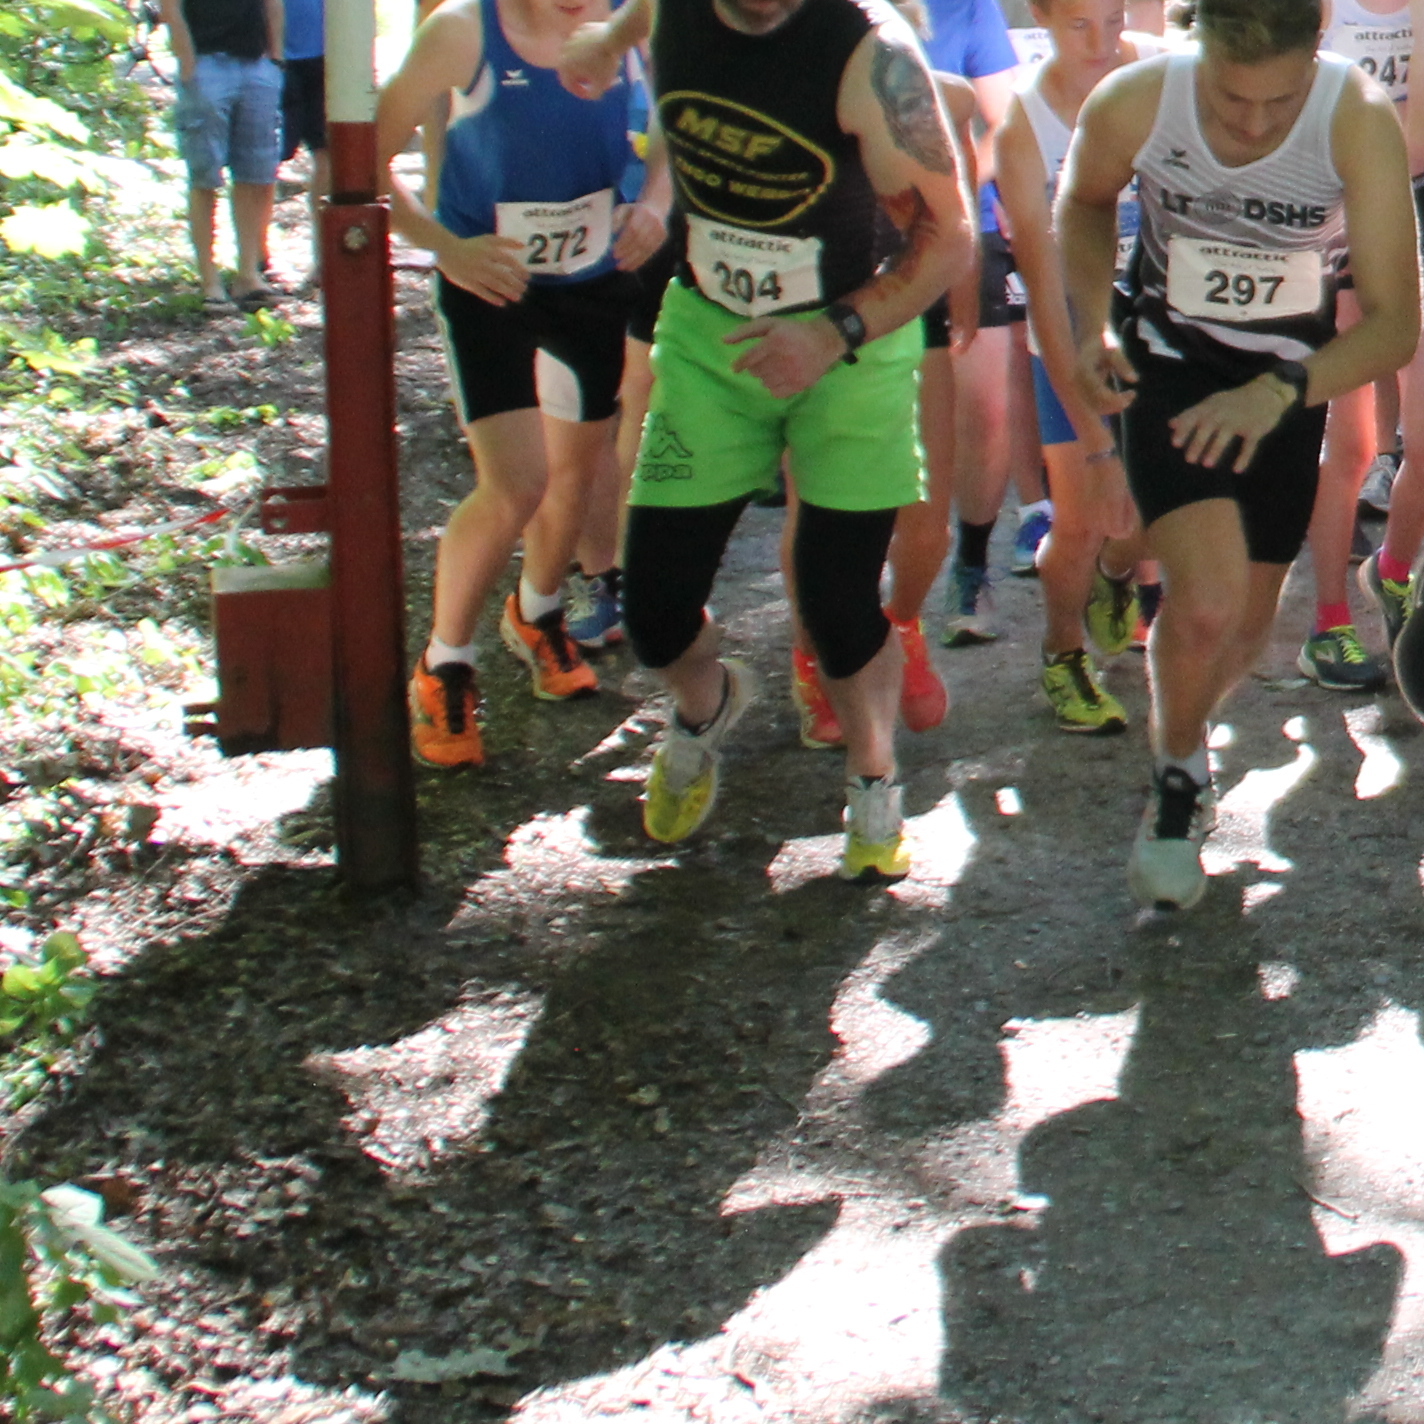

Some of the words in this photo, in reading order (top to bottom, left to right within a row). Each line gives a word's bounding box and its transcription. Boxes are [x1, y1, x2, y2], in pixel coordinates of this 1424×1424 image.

[676, 107, 783, 161] MSF
[1160, 188, 1193, 216] LT
[1243, 197, 1326, 227] DSHS
[526, 226, 588, 265] 272
[714, 260, 782, 305] 204
[1205, 270, 1284, 306] 297
